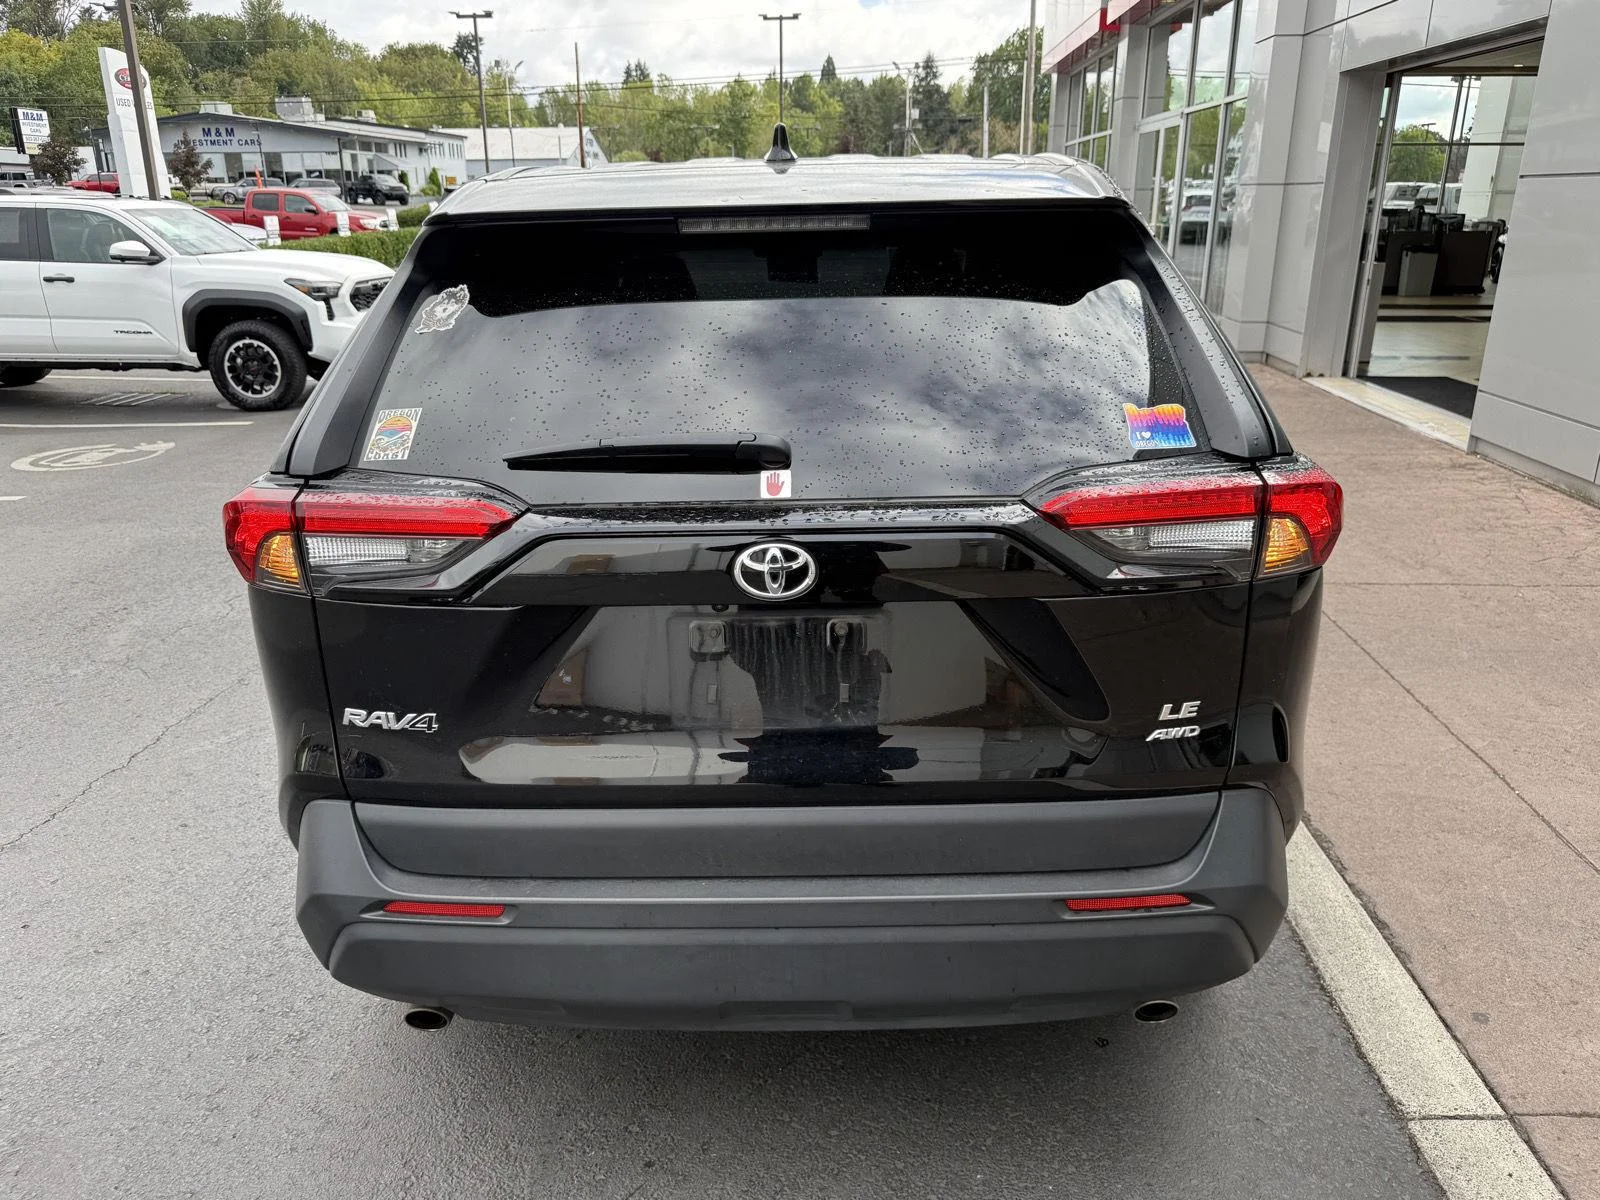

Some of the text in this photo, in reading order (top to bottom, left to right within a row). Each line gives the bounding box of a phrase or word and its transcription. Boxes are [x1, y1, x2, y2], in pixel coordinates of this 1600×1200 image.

[115, 97, 132, 108] USED
[22, 111, 44, 122] M&M
[202, 127, 212, 138] M
[225, 127, 235, 138] M
[177, 138, 262, 147] INESTMENT CARS
[379, 408, 421, 424] OREGON
[1158, 700, 1202, 721] LE
[342, 707, 439, 733] RAV4
[1145, 725, 1201, 742] AWD
